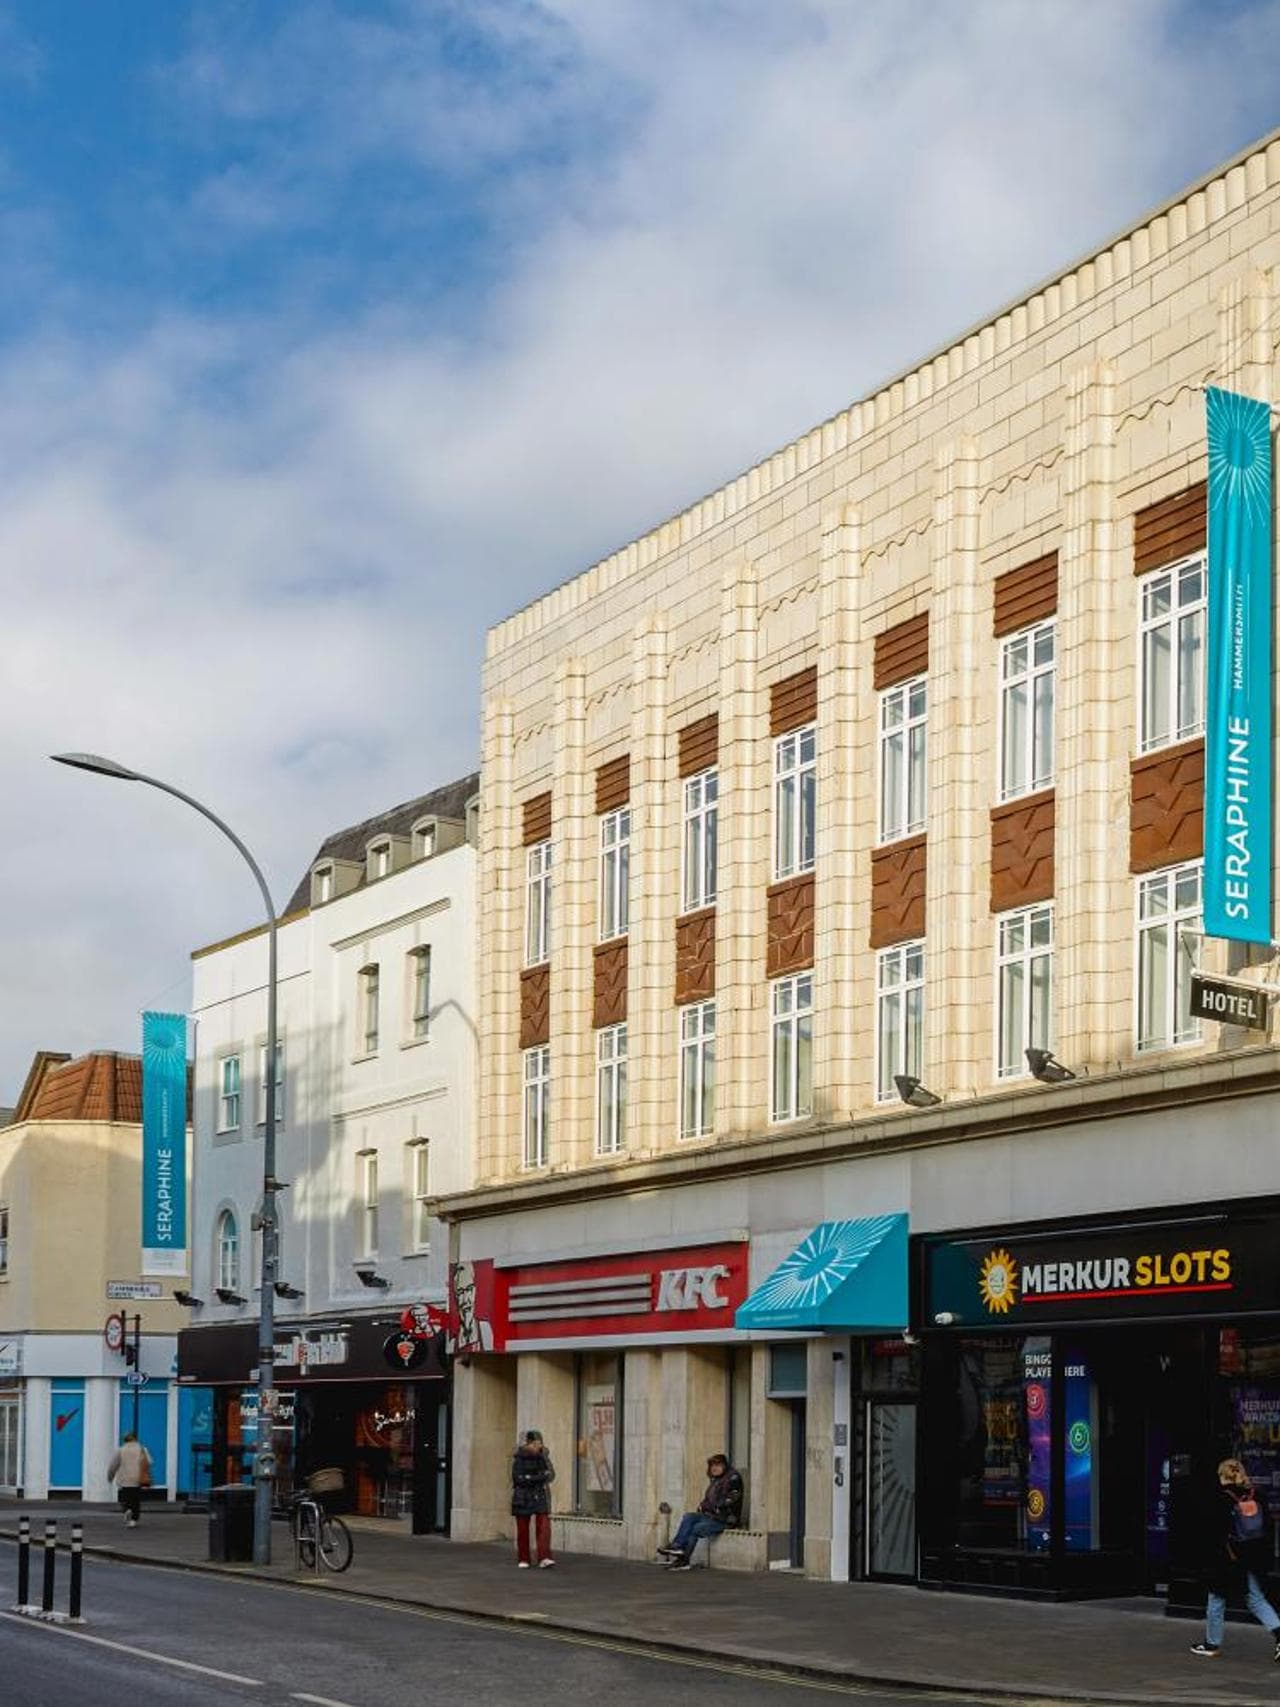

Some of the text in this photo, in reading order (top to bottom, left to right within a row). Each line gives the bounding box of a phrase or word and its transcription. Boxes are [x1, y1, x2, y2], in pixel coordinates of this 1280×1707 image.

[1233, 584, 1245, 690] HAMMERSMITH
[1225, 715, 1252, 920] SERAPHINE
[1201, 989, 1257, 1019] HOTEL
[157, 1149, 172, 1241] SERAPHINE
[655, 1264, 730, 1311] KFC
[1022, 1249, 1231, 1294] MERKUR SLOTS
[1025, 1366, 1052, 1378] PLAYE
